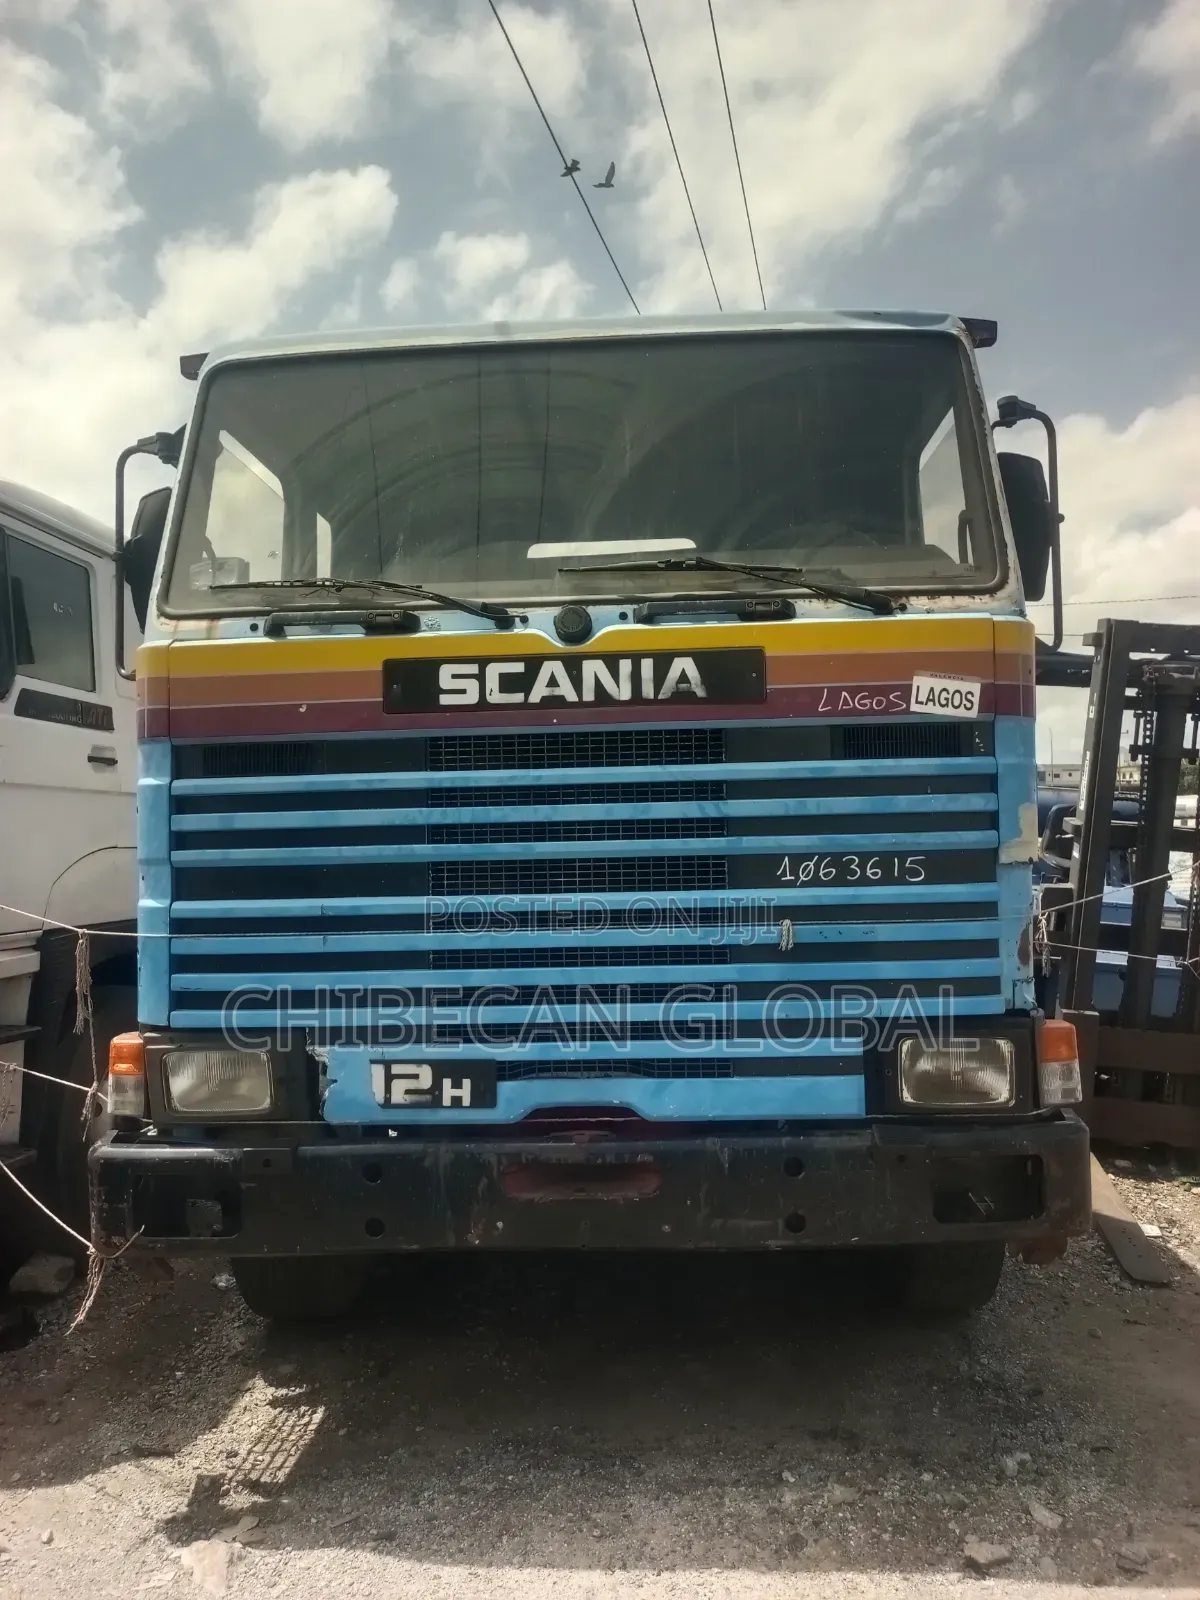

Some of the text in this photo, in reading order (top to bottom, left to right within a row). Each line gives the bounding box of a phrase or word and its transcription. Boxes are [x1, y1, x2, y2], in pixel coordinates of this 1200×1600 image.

[438, 656, 708, 706] SCANIA
[817, 687, 907, 712] LAGOS
[914, 684, 975, 711] LAGOS
